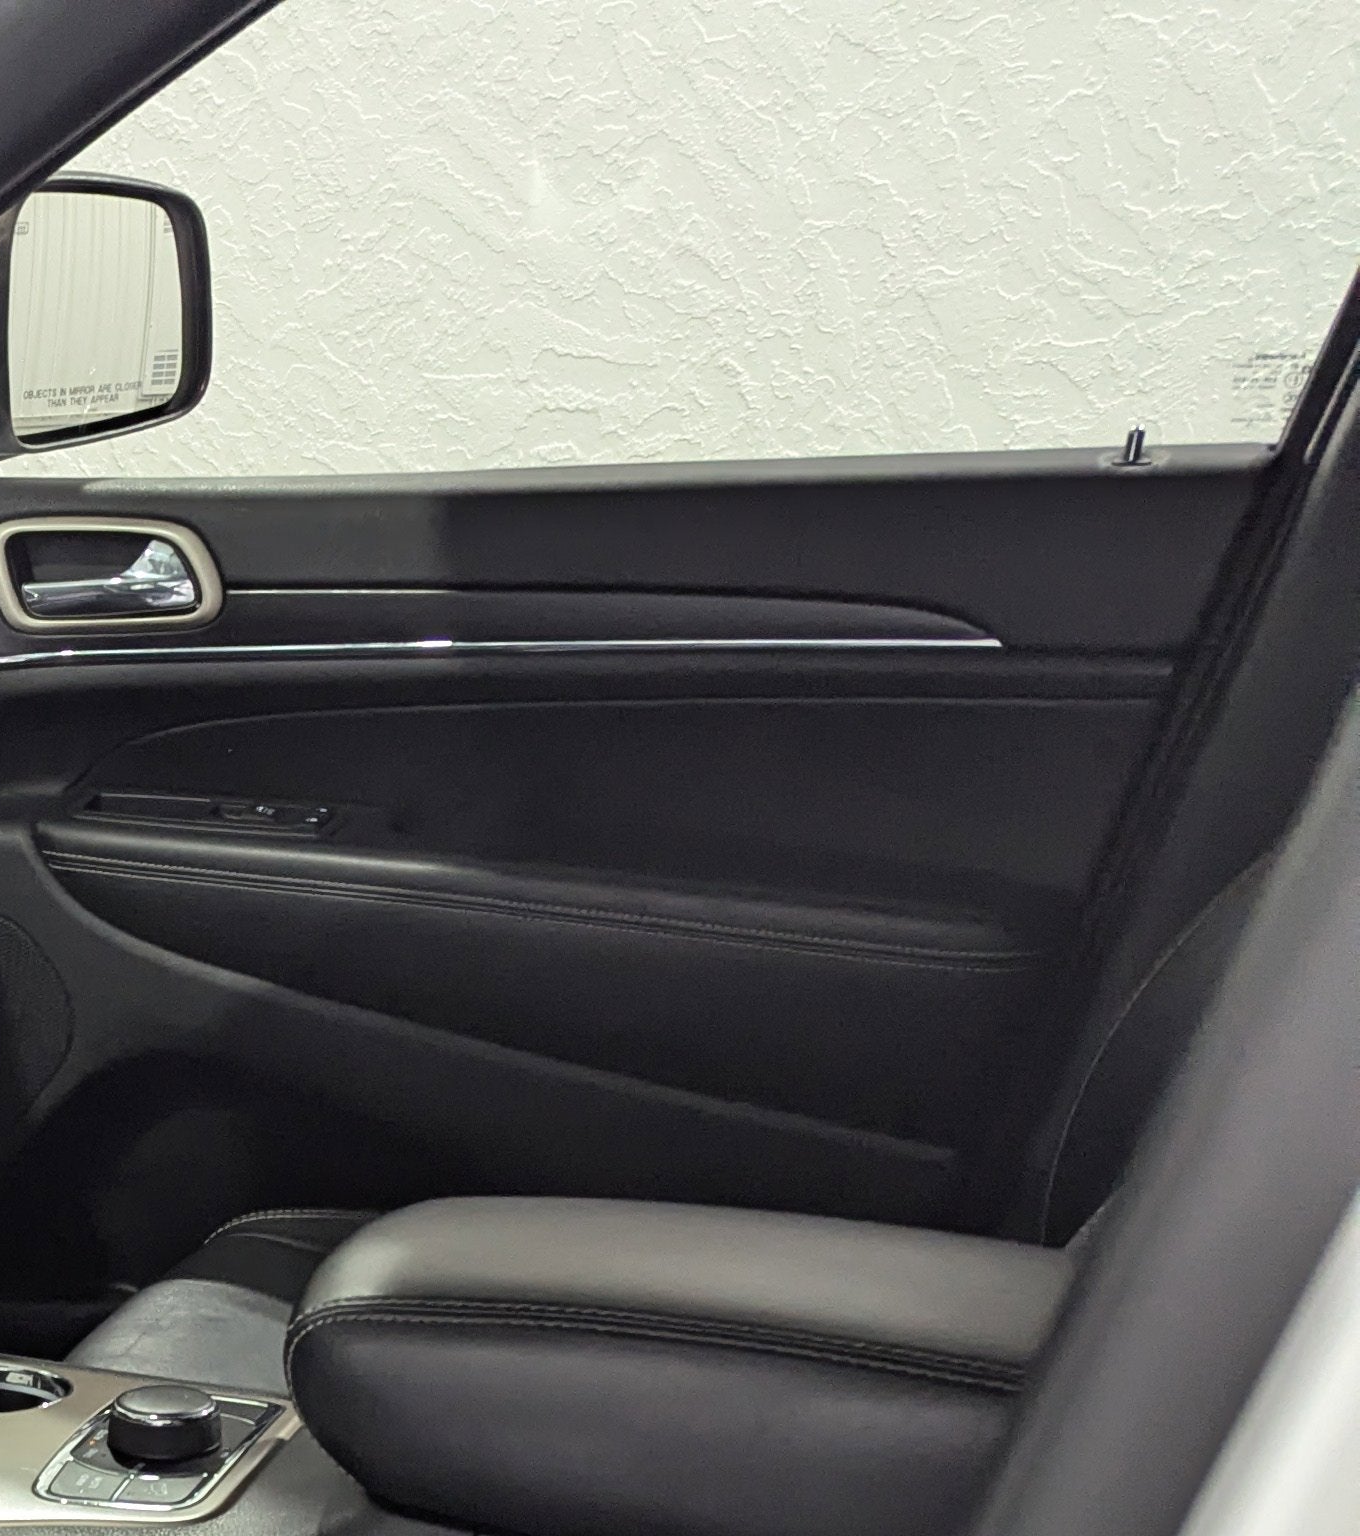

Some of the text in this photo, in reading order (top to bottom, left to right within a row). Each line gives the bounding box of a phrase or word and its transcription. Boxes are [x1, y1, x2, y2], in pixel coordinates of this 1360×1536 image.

[23, 381, 142, 400] OBJECTS IN MIRROR ARE CLOSER
[48, 393, 119, 408] THAN THEY APPEAR
